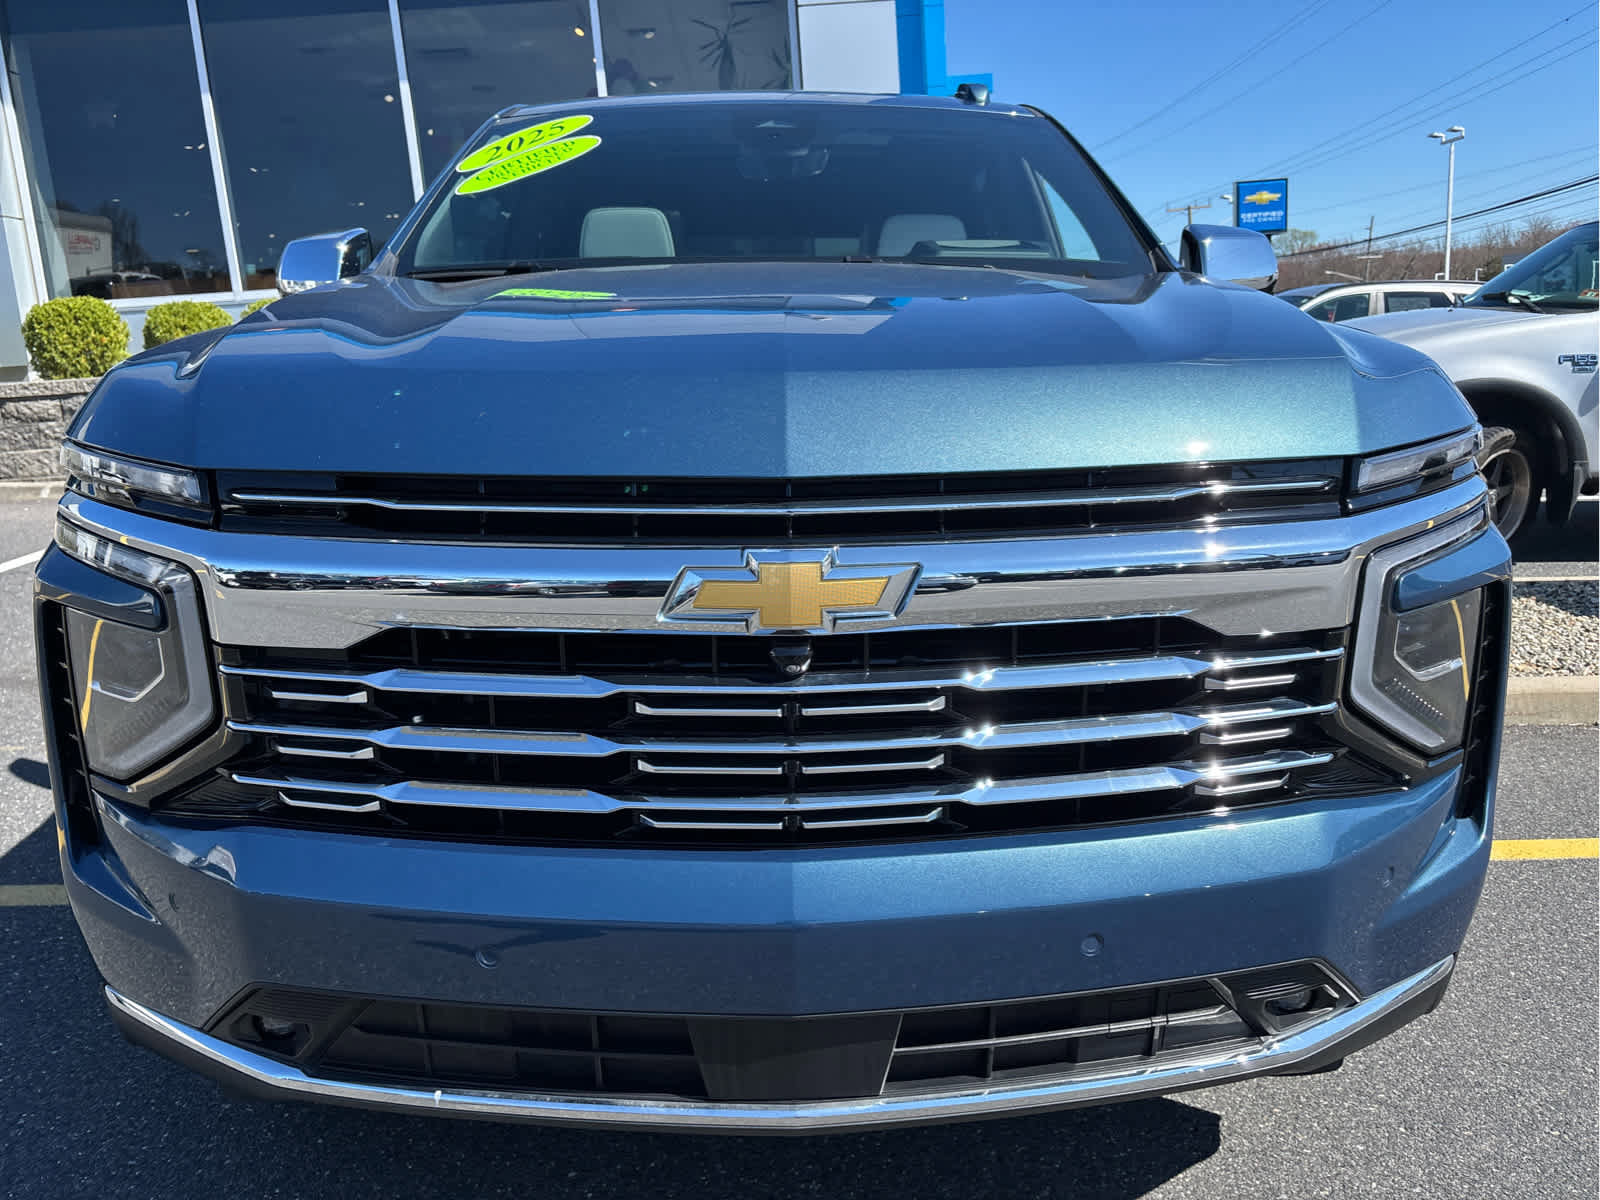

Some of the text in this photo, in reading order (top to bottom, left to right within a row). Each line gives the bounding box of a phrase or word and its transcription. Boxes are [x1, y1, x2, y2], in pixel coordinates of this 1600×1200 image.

[486, 121, 566, 164] 2025
[475, 140, 577, 182] CERTIFIED
[501, 153, 562, 181] VEHICLE
[1240, 211, 1284, 219] CERTIFIED
